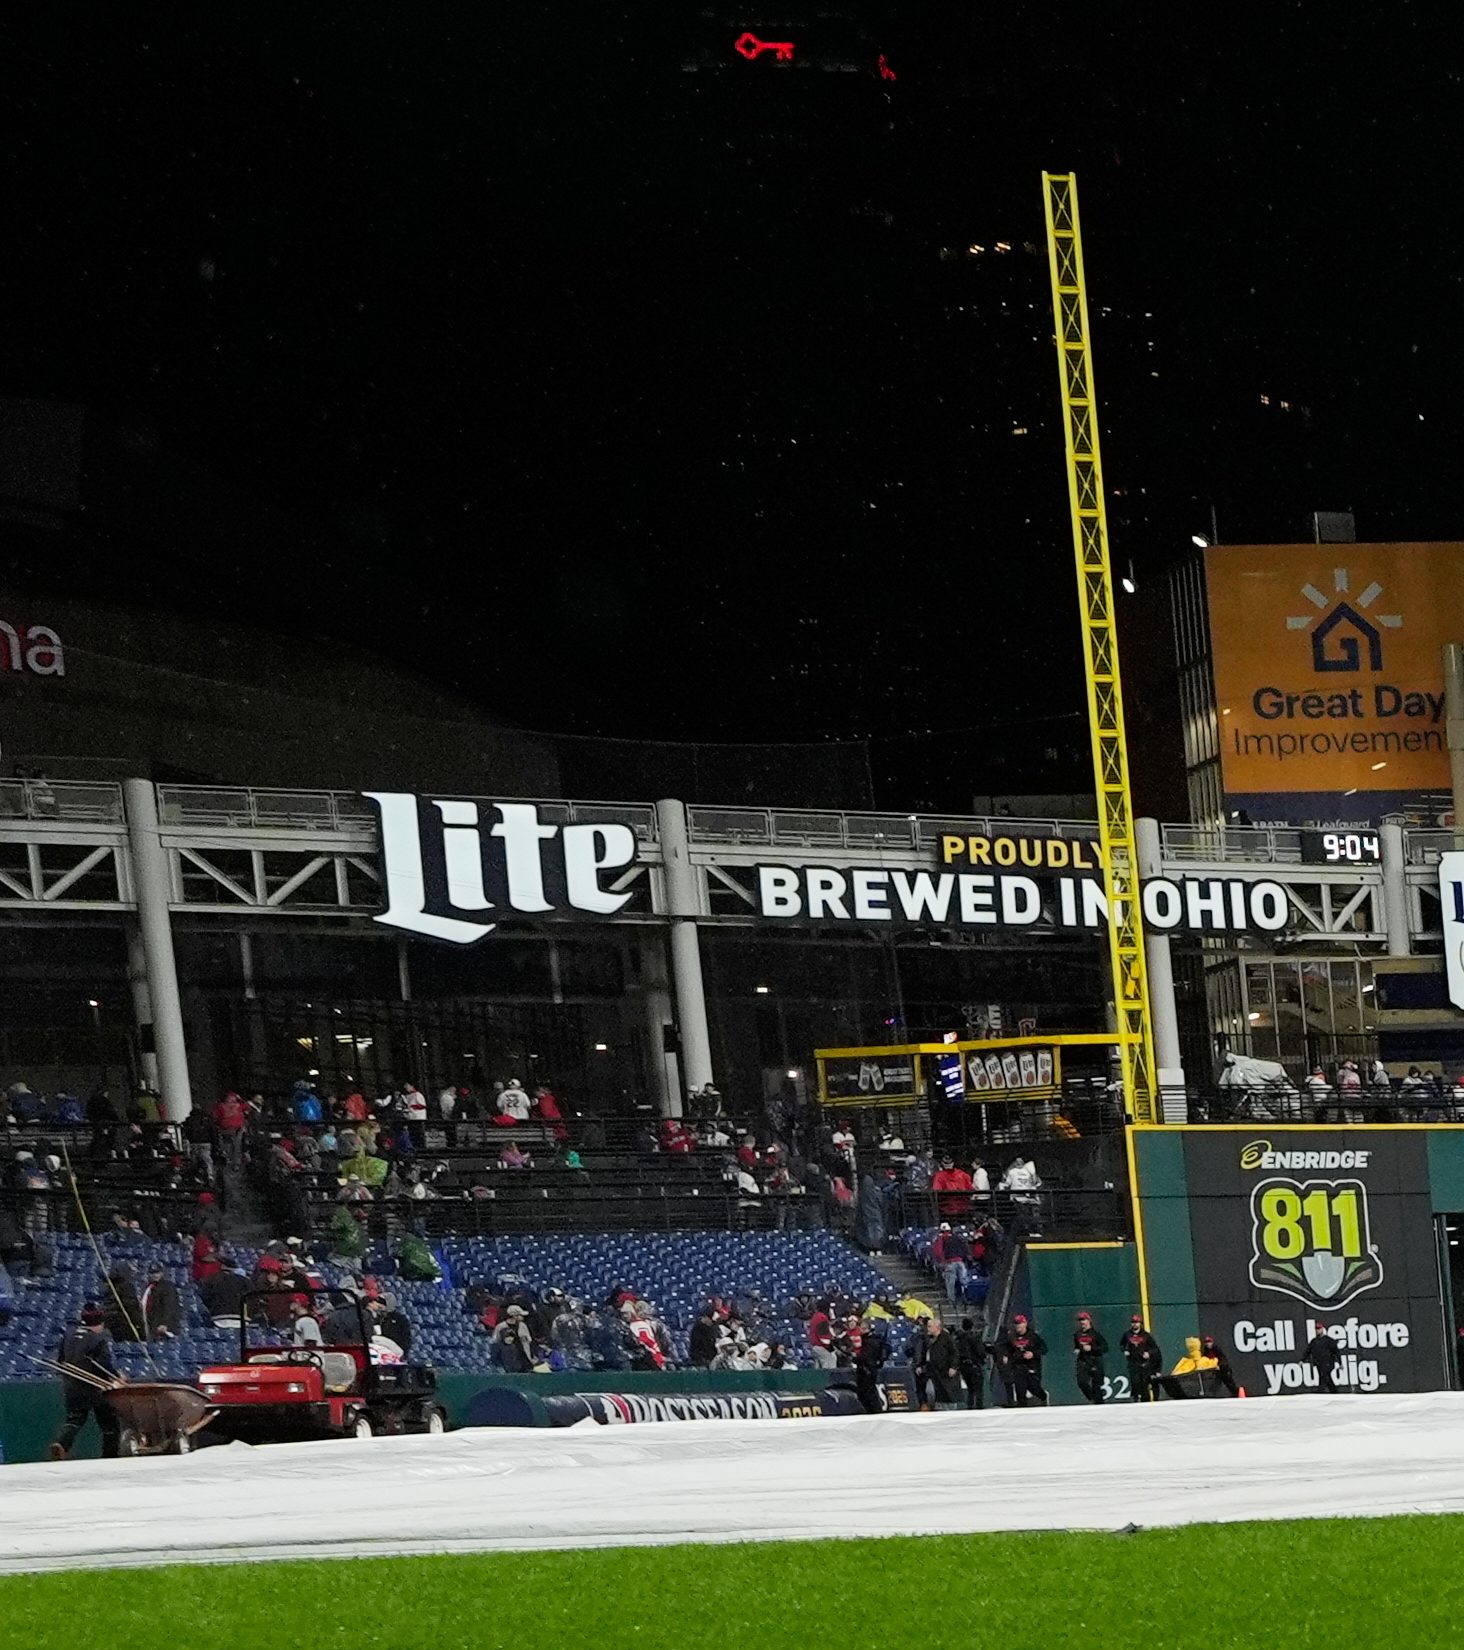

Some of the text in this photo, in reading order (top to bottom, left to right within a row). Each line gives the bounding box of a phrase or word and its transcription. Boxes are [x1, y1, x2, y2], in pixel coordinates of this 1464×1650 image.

[1253, 685, 1447, 723] Great Day
[1234, 727, 1443, 761] Improvemen
[943, 836, 1104, 869] PROUDLY
[1323, 834, 1379, 859] 9:04
[362, 791, 639, 943] Lite
[761, 867, 1288, 930] BREWED IN OHIO
[1261, 1150, 1369, 1169] ENBRIDGE
[1261, 1187, 1361, 1260] 811
[1234, 1319, 1295, 1353] Call
[1101, 1375, 1131, 1399] 32
[1264, 1355, 1387, 1395] you dig.
